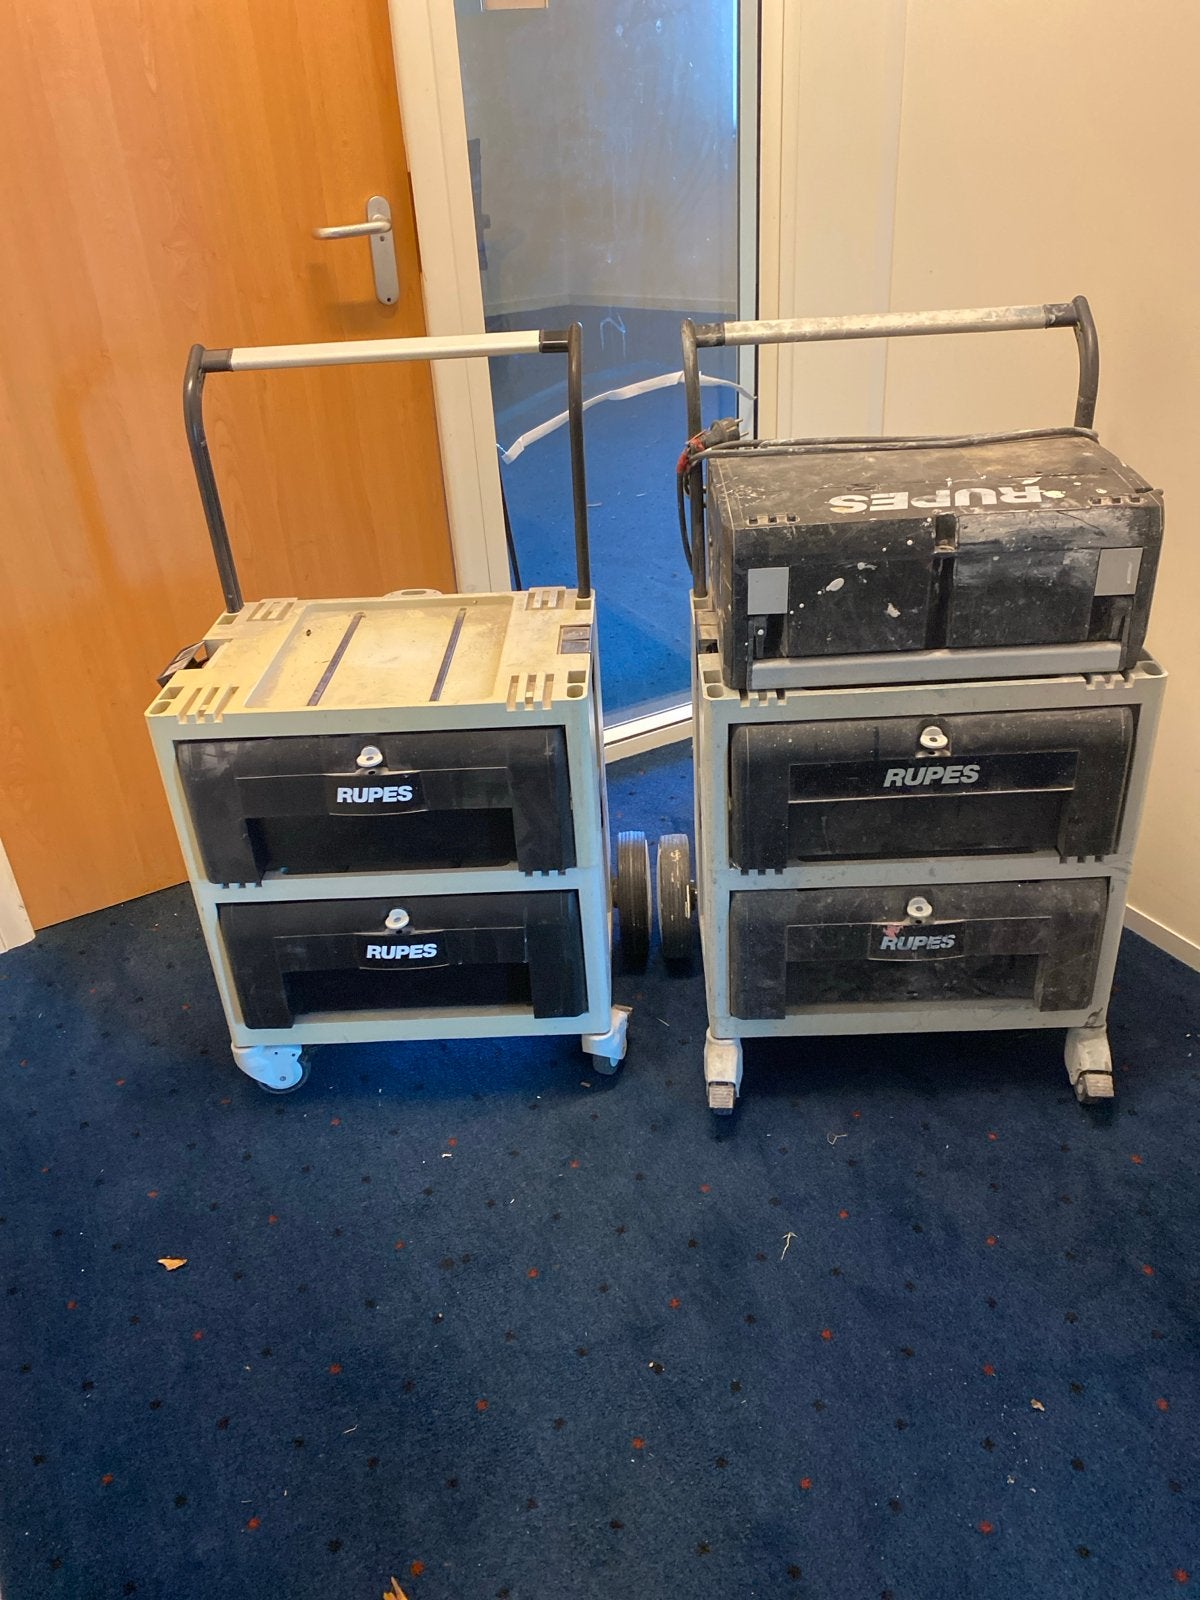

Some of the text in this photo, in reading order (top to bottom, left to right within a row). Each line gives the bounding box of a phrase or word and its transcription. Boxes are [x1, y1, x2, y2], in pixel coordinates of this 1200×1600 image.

[829, 485, 1042, 514] RUPES
[883, 764, 980, 787] RUPES
[336, 785, 413, 803] RUPES
[366, 943, 438, 959] RUPES
[880, 934, 956, 950] RUPES
